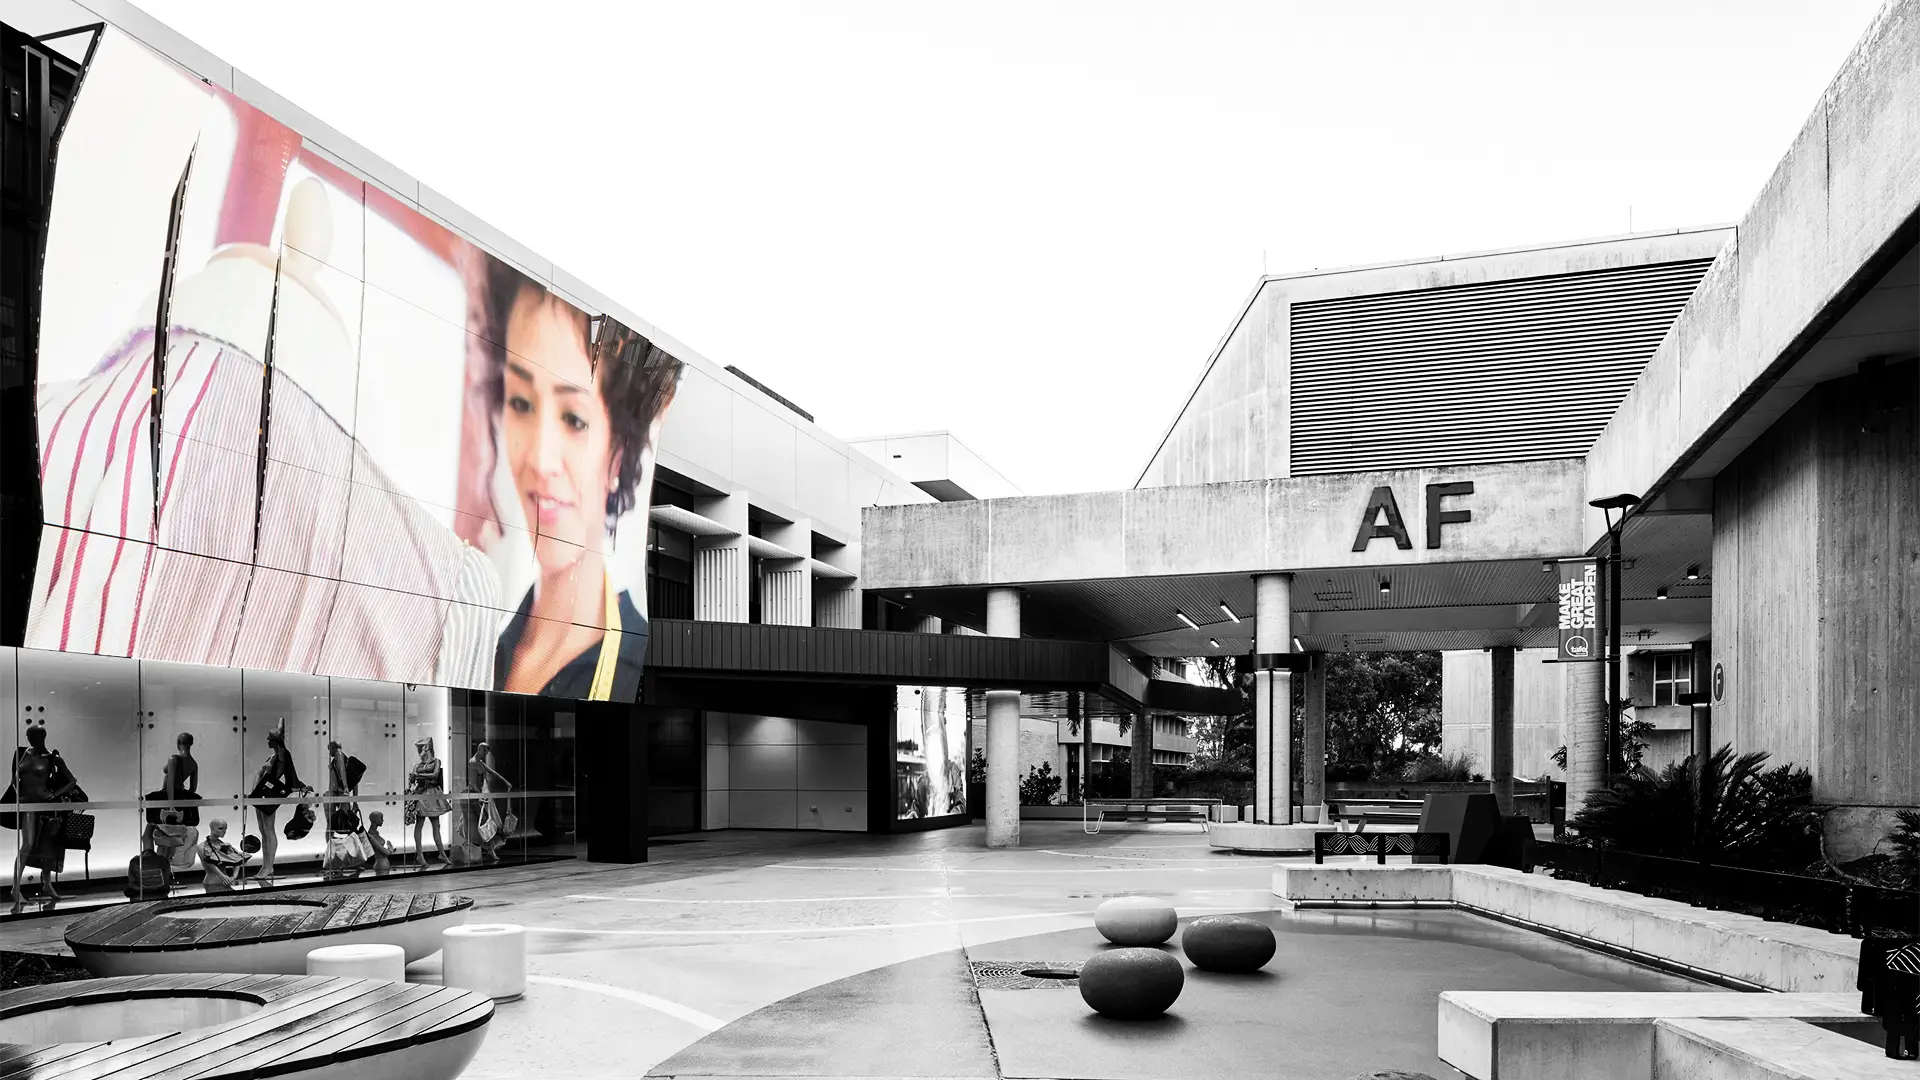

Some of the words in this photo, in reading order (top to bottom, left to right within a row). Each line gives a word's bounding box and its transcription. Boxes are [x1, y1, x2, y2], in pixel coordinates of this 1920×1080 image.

[1352, 481, 1474, 552] AF
[1559, 583, 1571, 629] MAKE
[1571, 578, 1584, 628] GREAT
[1584, 564, 1596, 628] HAPPEN
[1716, 668, 1721, 695] F
